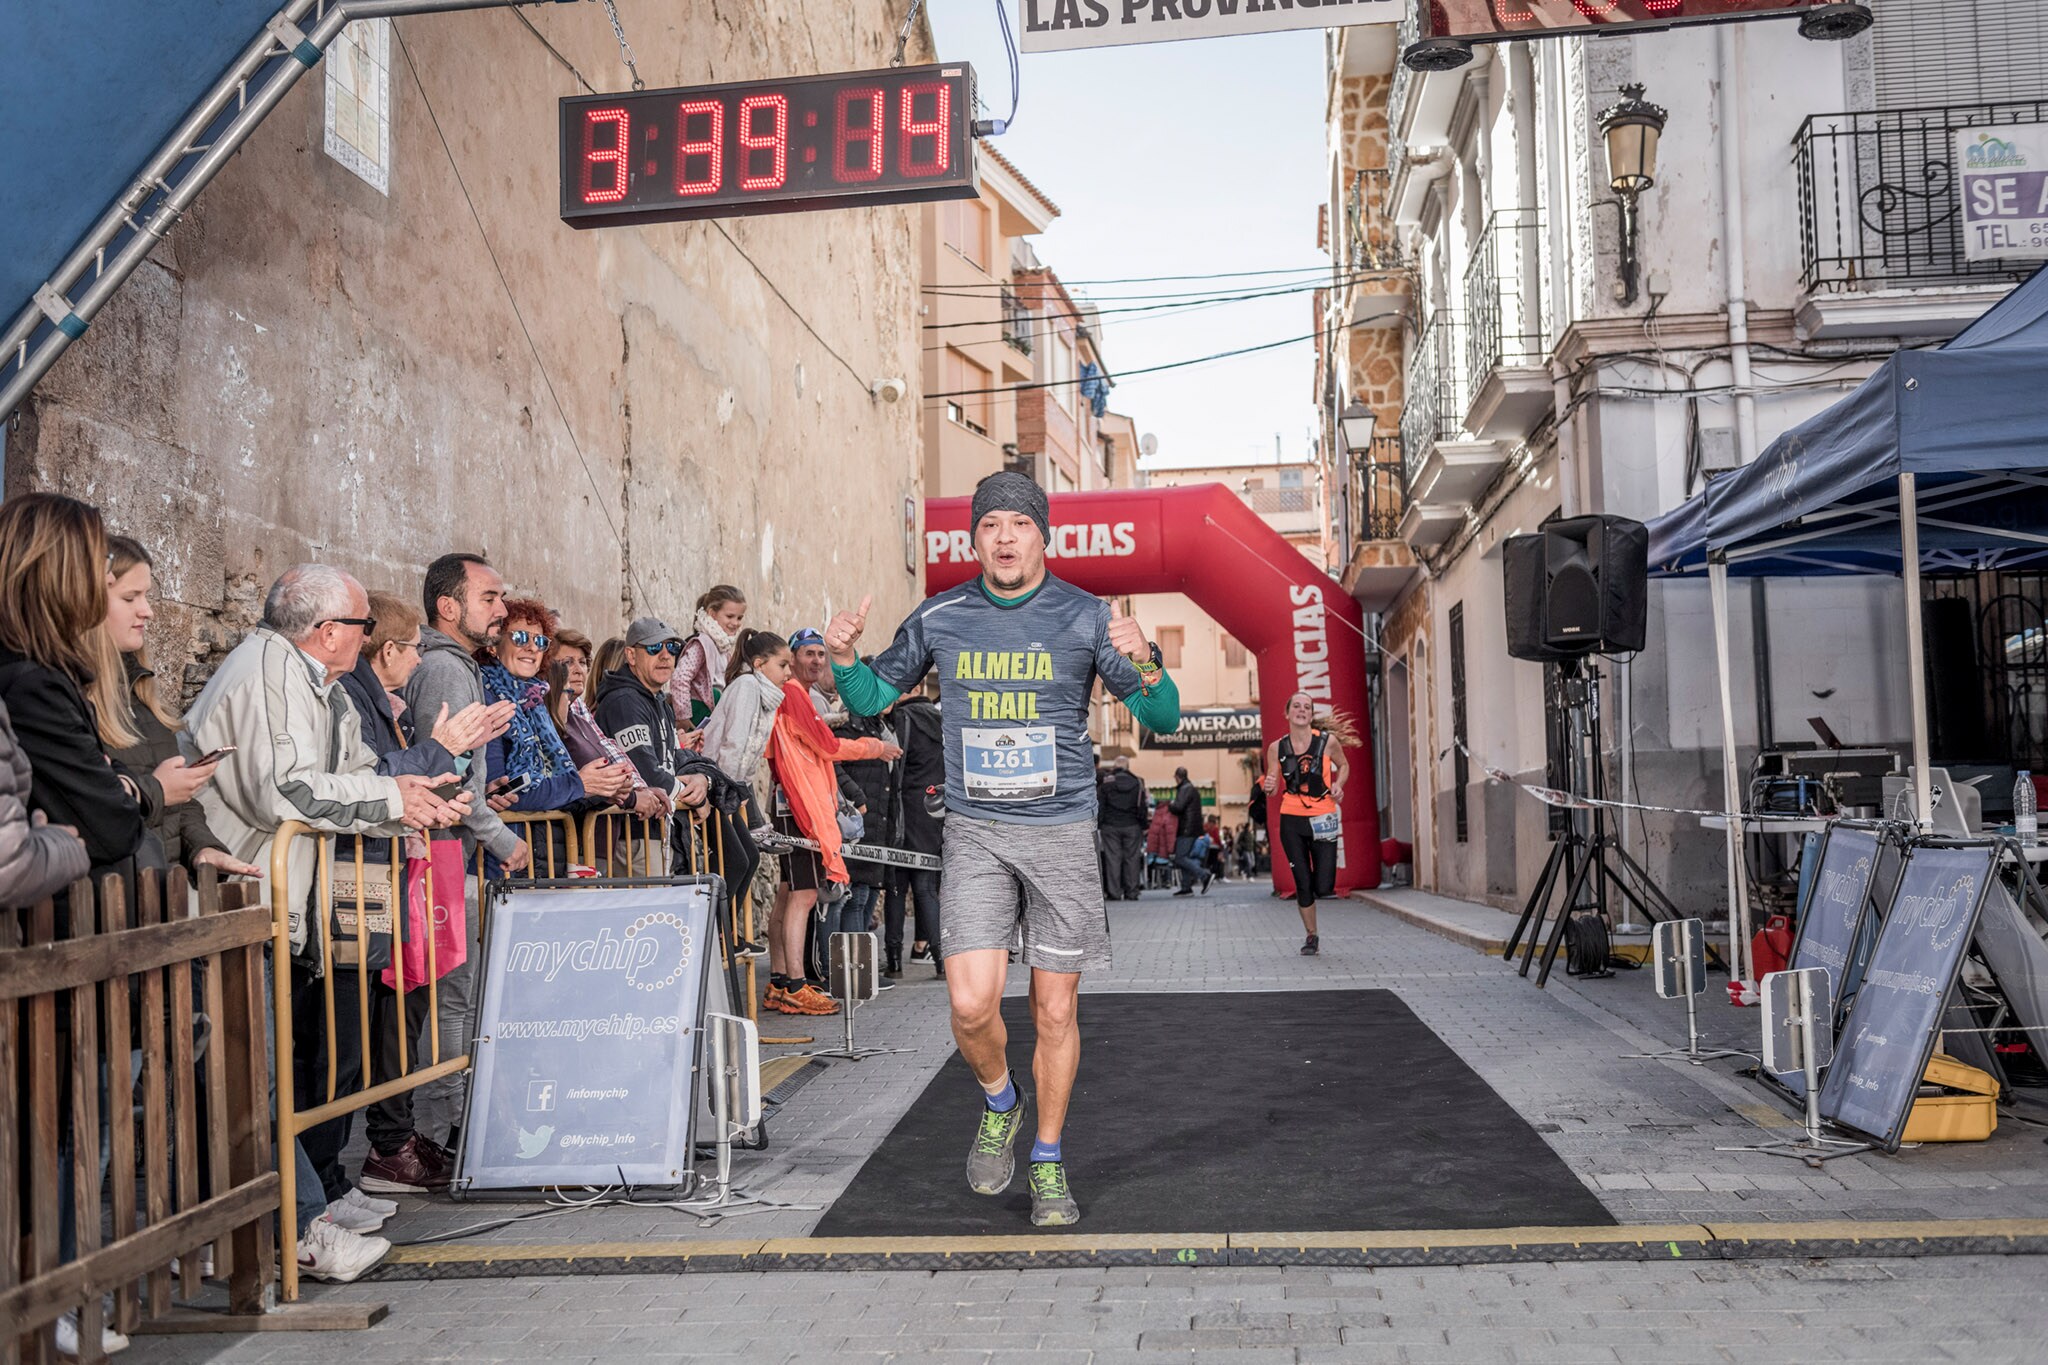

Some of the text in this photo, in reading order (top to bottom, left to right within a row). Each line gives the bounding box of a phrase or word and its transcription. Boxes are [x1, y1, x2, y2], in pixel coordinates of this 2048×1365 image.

[1972, 177, 2019, 216] SE
[955, 651, 1054, 681] ALMEJA
[967, 691, 1040, 720] TRAIL
[620, 728, 648, 748] CORE
[1190, 733, 1214, 745] para
[981, 750, 1034, 769] 1261
[506, 927, 659, 982] mychip
[498, 1013, 679, 1042] www.mychip.es
[566, 1087, 629, 1100] /infomychip
[560, 1133, 636, 1148] @Mychip_Info
